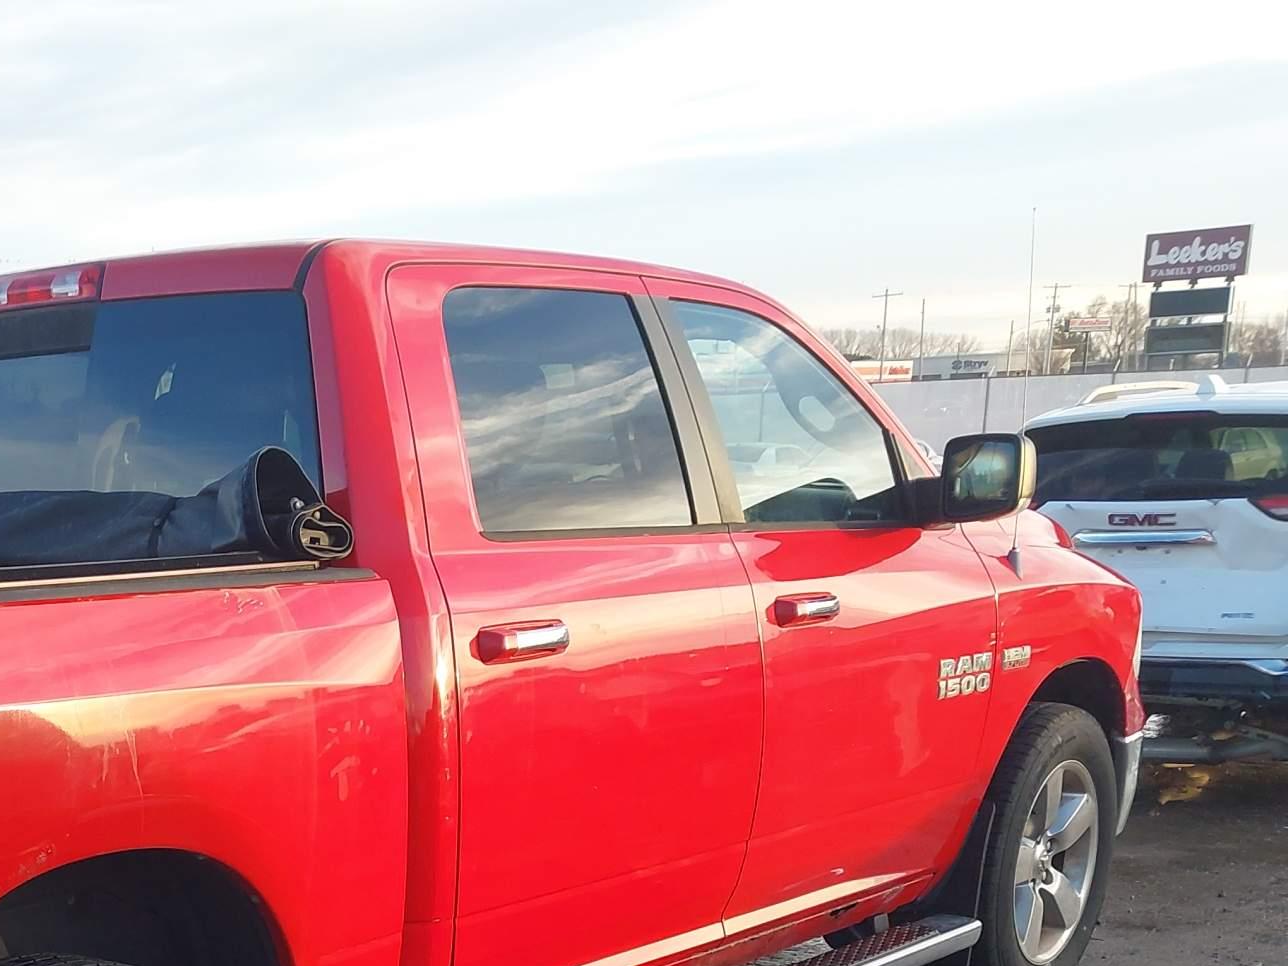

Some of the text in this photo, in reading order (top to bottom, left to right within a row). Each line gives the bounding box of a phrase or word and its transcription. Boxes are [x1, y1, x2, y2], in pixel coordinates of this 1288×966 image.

[1147, 236, 1245, 266] Leeker's
[1151, 263, 1237, 277] FAMILY FOODS
[1108, 513, 1177, 526] GMC
[939, 652, 993, 679] RAM
[937, 672, 991, 700] 1500
